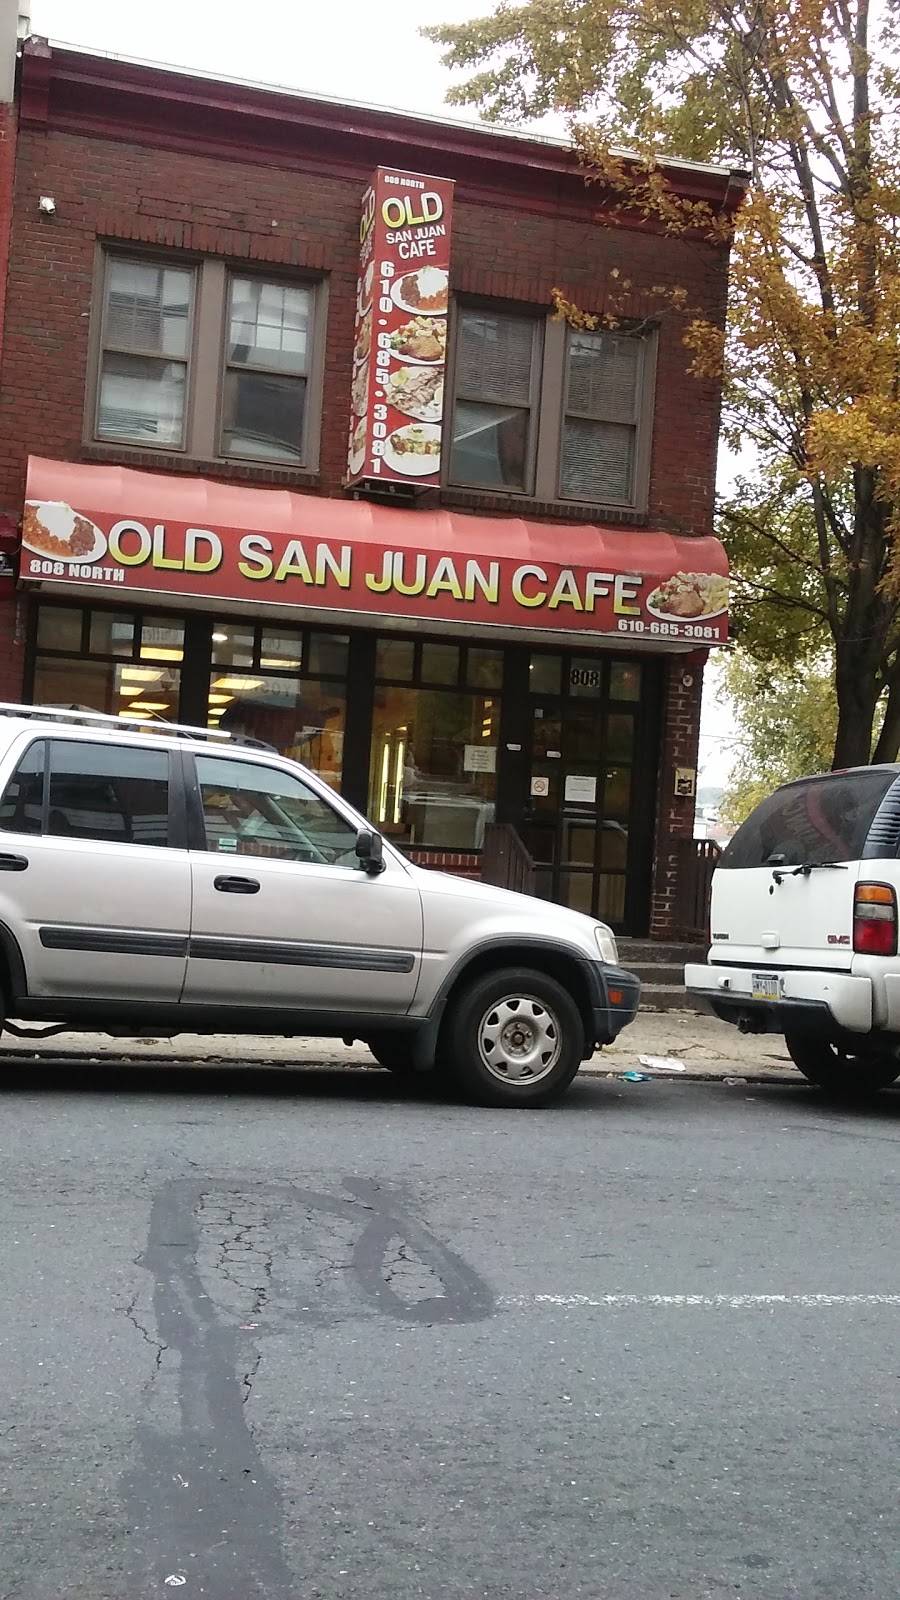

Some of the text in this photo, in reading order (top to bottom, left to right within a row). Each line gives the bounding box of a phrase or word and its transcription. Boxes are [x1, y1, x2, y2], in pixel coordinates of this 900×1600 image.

[400, 178, 425, 190] NORTH
[382, 192, 443, 229] OLD
[386, 225, 446, 245] SAN JUAN
[398, 239, 436, 260] CAFE
[30, 559, 125, 582] 808 NORTH
[108, 520, 643, 616] OLD SAN JUAN CAFE
[617, 618, 720, 639] 610-685-3081
[570, 668, 599, 688] 808
